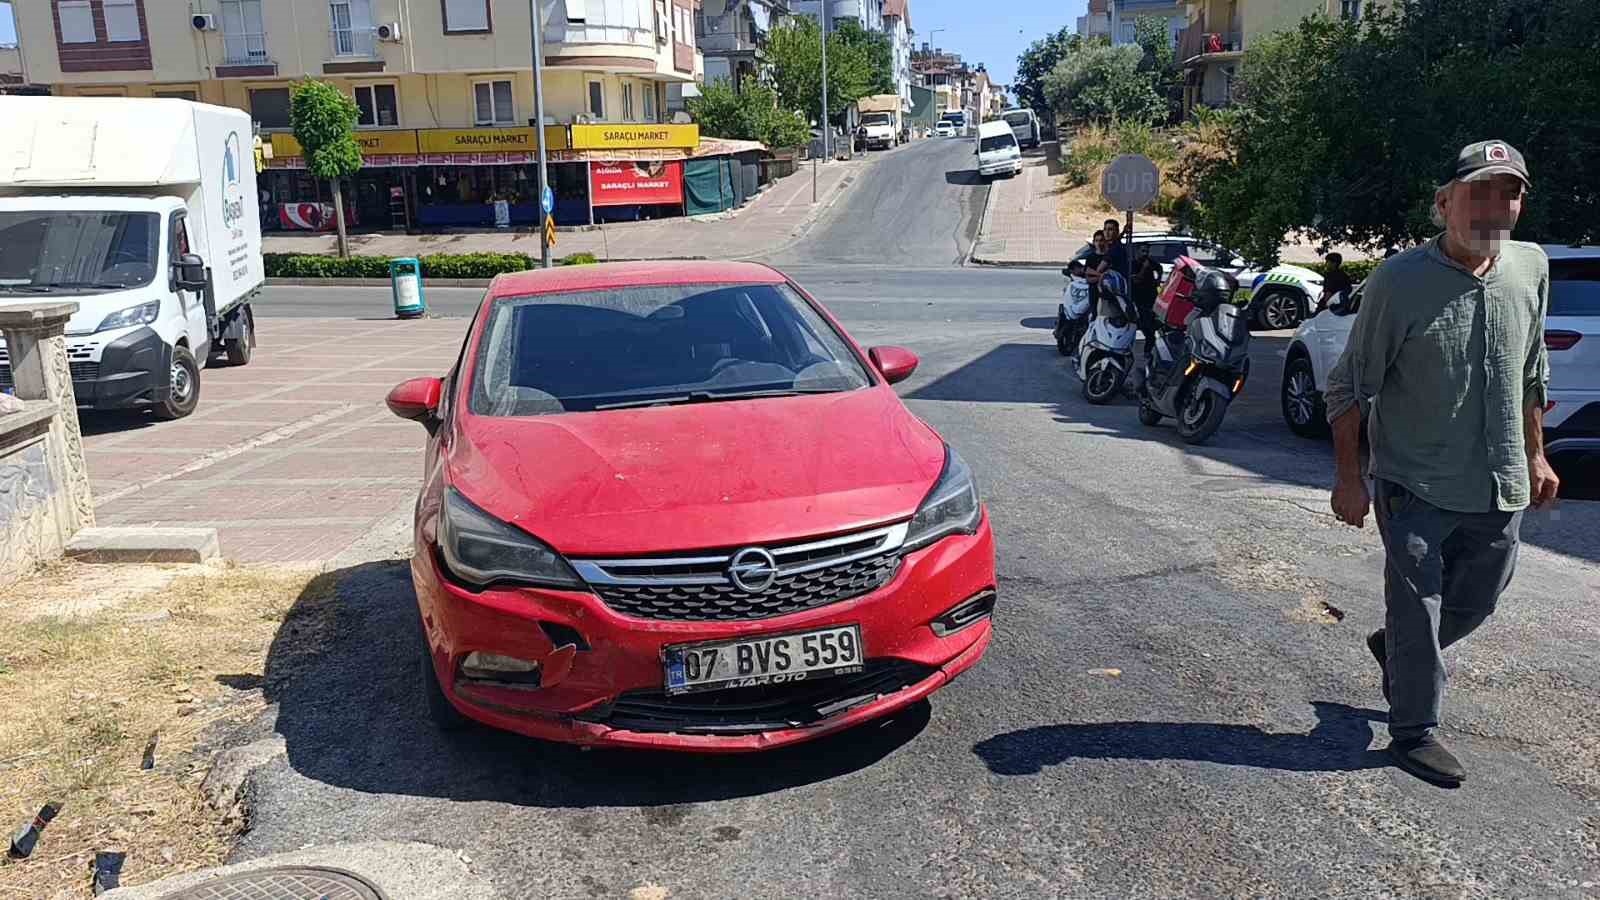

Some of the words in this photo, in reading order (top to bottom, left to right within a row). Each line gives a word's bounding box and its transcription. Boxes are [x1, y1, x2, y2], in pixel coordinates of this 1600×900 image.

[492, 134, 528, 144] MARKET
[637, 131, 668, 141] MARKET
[636, 181, 669, 190] MARKET
[1107, 172, 1153, 193] DUR
[685, 649, 718, 680] 07
[736, 639, 792, 675] BVS
[802, 630, 856, 666] 559
[671, 670, 684, 680] TR
[773, 671, 807, 682] OTO
